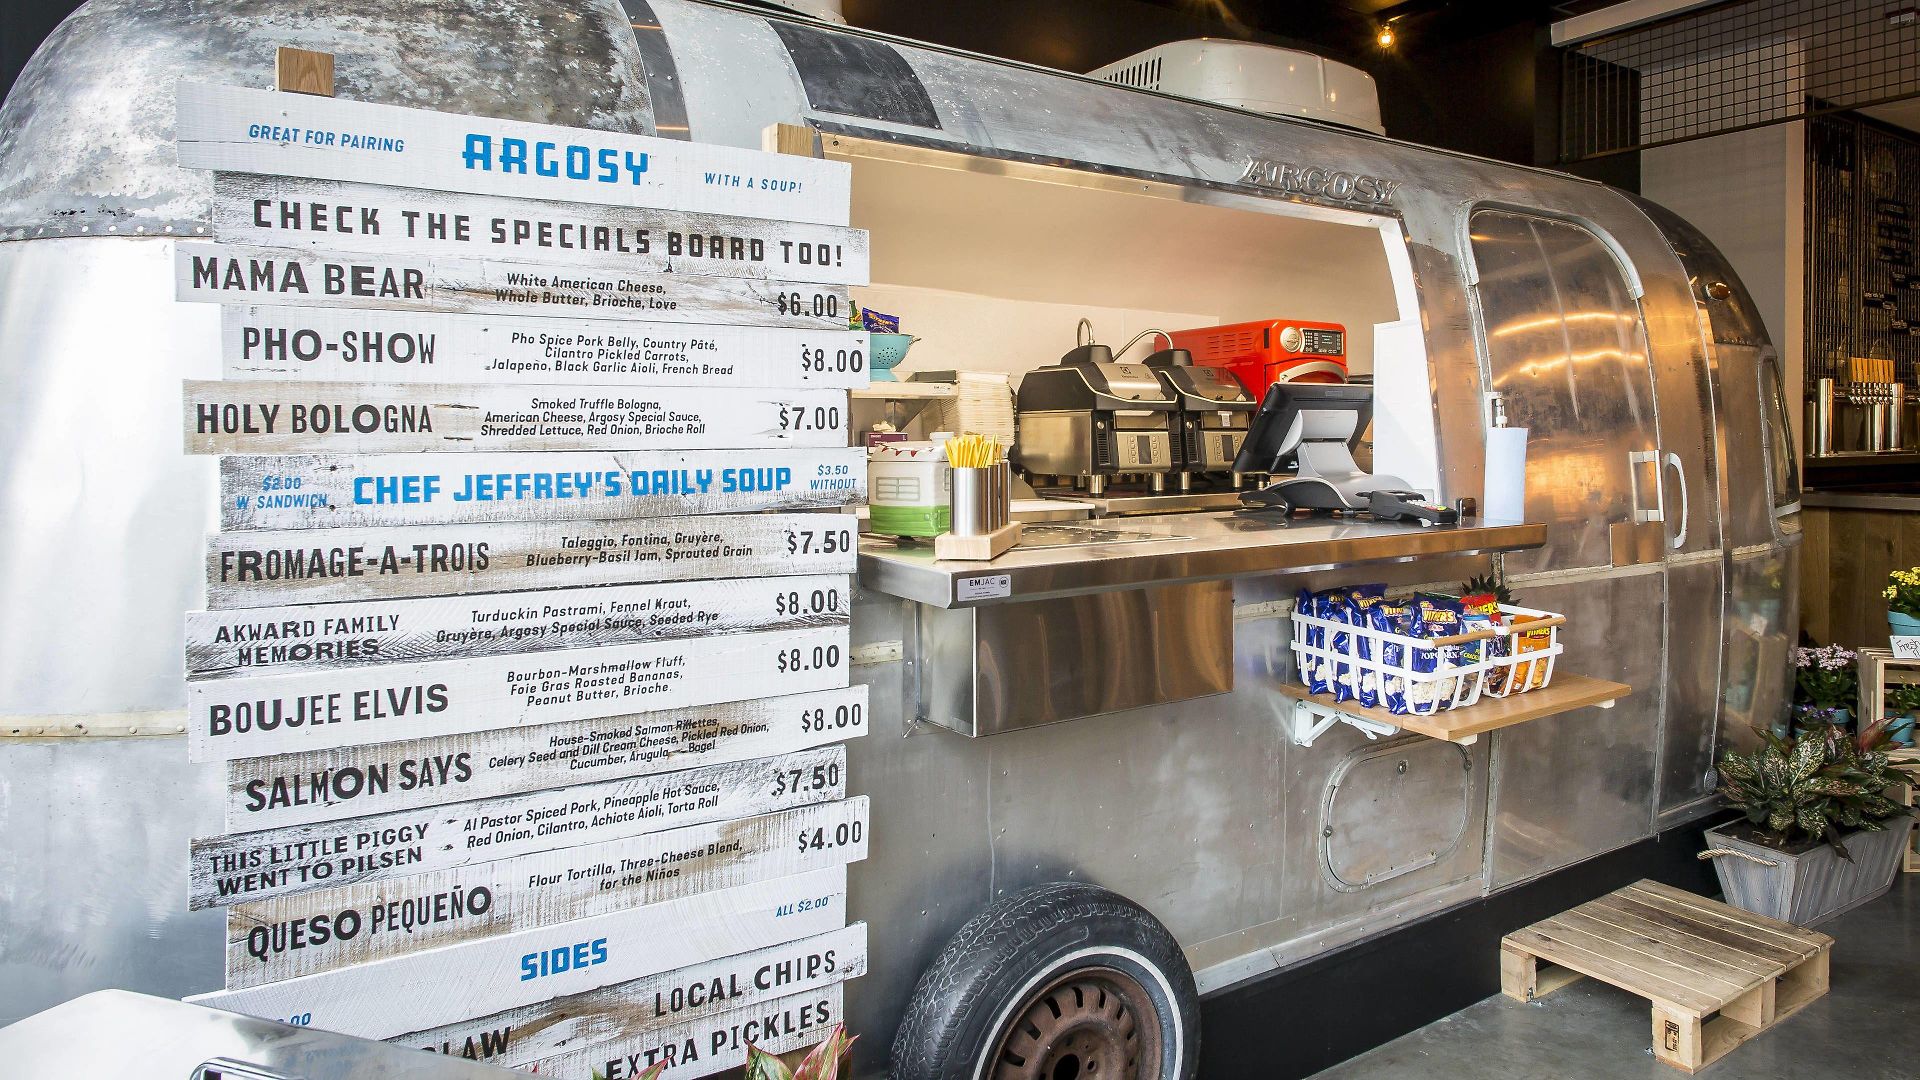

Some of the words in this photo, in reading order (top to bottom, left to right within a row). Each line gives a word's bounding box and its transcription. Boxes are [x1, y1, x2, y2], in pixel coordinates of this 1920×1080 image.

[250, 125, 300, 142] GREAT
[305, 130, 335, 145] FOR
[341, 134, 404, 152] PAIRING
[462, 133, 648, 185] ARGOSY
[705, 172, 739, 187] WITH
[747, 177, 753, 188] A
[762, 179, 802, 193] SOUP!
[254, 200, 379, 235] CHECK
[402, 211, 470, 241] THE
[491, 218, 650, 253] SPECIALS
[668, 232, 763, 261] BOARD
[780, 241, 842, 267] TOO!
[193, 256, 309, 293] MAMA
[325, 264, 424, 299] BEAR
[507, 273, 547, 287] White
[552, 277, 612, 291] American
[618, 280, 666, 295] Cheese,
[496, 289, 538, 303] Whole
[543, 292, 588, 307] Butter,
[593, 295, 645, 309] Brioche,
[650, 298, 676, 310] Love
[778, 292, 837, 318] $6.00
[244, 327, 435, 364] PHO-SHOW
[512, 333, 534, 344] Pho
[539, 334, 572, 348] Spice
[577, 336, 603, 346] Pork
[608, 337, 639, 349] Belly,
[643, 338, 686, 352] Country
[691, 339, 718, 351] Pâté,
[546, 347, 593, 359] Cilantro
[598, 349, 639, 360] Pickled
[644, 351, 688, 362] Carrots,
[492, 359, 550, 373] Jalapeño,
[555, 361, 588, 371] Black
[593, 362, 626, 372] Garlic
[631, 363, 658, 374] Aioli,
[662, 364, 698, 374] French
[702, 365, 733, 375] Bread
[802, 349, 863, 372] $8.00
[485, 412, 539, 423] American
[542, 413, 585, 424] Cheese,
[589, 413, 625, 425] Argosy
[628, 413, 666, 425] Special
[669, 413, 701, 423] Sauce,
[532, 399, 576, 409] Smoked
[580, 399, 614, 409] Truffle
[618, 400, 661, 412] Bologna,
[779, 407, 838, 430] $7.00
[197, 404, 280, 434] HOLY
[292, 404, 432, 434] BOLOGNA
[481, 425, 535, 436] Shredded
[539, 426, 584, 436] Lettuce,
[587, 425, 607, 435] Red
[611, 425, 642, 435] Onion,
[645, 425, 683, 434] Brioche
[686, 424, 705, 434] Roll
[818, 465, 848, 476] $3.50
[262, 476, 301, 492] $2.00
[354, 476, 440, 505] CHEF
[454, 471, 621, 501] JEFFREY'S
[632, 469, 712, 496] DAILY
[722, 467, 791, 493] SOUP
[810, 479, 856, 490] WITHOUT
[236, 496, 250, 510] W
[257, 494, 327, 509] SANDWICH
[561, 536, 617, 551] Taleggio,
[622, 534, 671, 547] Fontina,
[674, 531, 724, 546] Gruyère,
[788, 530, 849, 555] $7.50
[221, 542, 489, 582] FROMAGE-A-TROIS
[527, 552, 630, 568] Blueberry-Basil
[634, 549, 661, 563] Jam,
[666, 547, 719, 561] Sprouted
[723, 546, 752, 558] Grain
[970, 578, 994, 586] EMJAC
[472, 608, 538, 623] Turduckin
[543, 603, 606, 618] Pastrami,
[611, 600, 651, 612] Fennel
[655, 598, 691, 611] Kraut,
[776, 589, 837, 615] $8.00
[215, 620, 315, 643] AKWARD
[324, 615, 399, 635] FAMILY
[239, 639, 379, 665] MEMORIES
[778, 645, 839, 673] $8.00
[507, 660, 652, 683] Bourbon-Marshmallow
[656, 655, 686, 668] Fluff,
[511, 683, 536, 695] Foie
[542, 681, 569, 692] Gras
[575, 676, 625, 688] Roasted
[630, 671, 683, 683] Bananas,
[527, 694, 571, 706] Peanut
[577, 689, 618, 701] Butter,
[624, 684, 672, 696] Brioche.
[210, 693, 341, 736] BOUJEE
[354, 684, 448, 721] ELVIS
[802, 704, 861, 732] $8.00
[489, 756, 525, 769] Celery
[529, 751, 556, 763] Seed
[560, 749, 579, 759] and
[582, 744, 600, 755] Dill
[603, 740, 636, 753] Cream
[640, 736, 678, 748] Cheese,
[682, 729, 717, 742] Pickled
[720, 727, 738, 737] Red
[741, 723, 769, 735] Onion,
[246, 763, 388, 812] SALMON
[400, 753, 472, 791] SAYS
[777, 764, 838, 796] $7.50
[480, 813, 522, 829] Pastor
[526, 804, 567, 822] Spiced
[571, 800, 600, 814] Pork,
[604, 792, 659, 809] Pineapple
[663, 788, 681, 799] Hot
[684, 783, 719, 796] Sauce,
[467, 835, 491, 848] Red
[496, 829, 534, 843] Onion,
[537, 819, 588, 836] Cilantro,
[592, 812, 634, 827] Achiote
[638, 805, 664, 819] Aioli,
[668, 801, 695, 814] Torta
[698, 796, 718, 808] Roll
[210, 850, 261, 873] THIS
[271, 836, 347, 864] LITTLE
[357, 823, 429, 850] PIGGY
[799, 821, 862, 853] $4.00
[218, 869, 290, 896] WENT
[298, 862, 332, 882] TO
[342, 846, 421, 875] PILSEN
[529, 872, 562, 888] Flour
[568, 863, 615, 880] Tortilla,
[621, 848, 703, 871] Three-Cheese
[708, 839, 742, 855] Blend,
[600, 878, 618, 891] for
[622, 873, 642, 886] the
[646, 867, 679, 881] Niños
[776, 903, 793, 917] ALL
[798, 897, 828, 912] $2.00
[248, 910, 361, 962] QUESO
[372, 885, 491, 935] PEQUEÑO
[521, 938, 607, 981] SIDES
[655, 974, 742, 1017] LOCAL
[754, 950, 835, 990] CHIPS
[420, 1027, 511, 1061] AW
[607, 1039, 699, 1080] EXTRA
[712, 1000, 830, 1055] PICKLES
